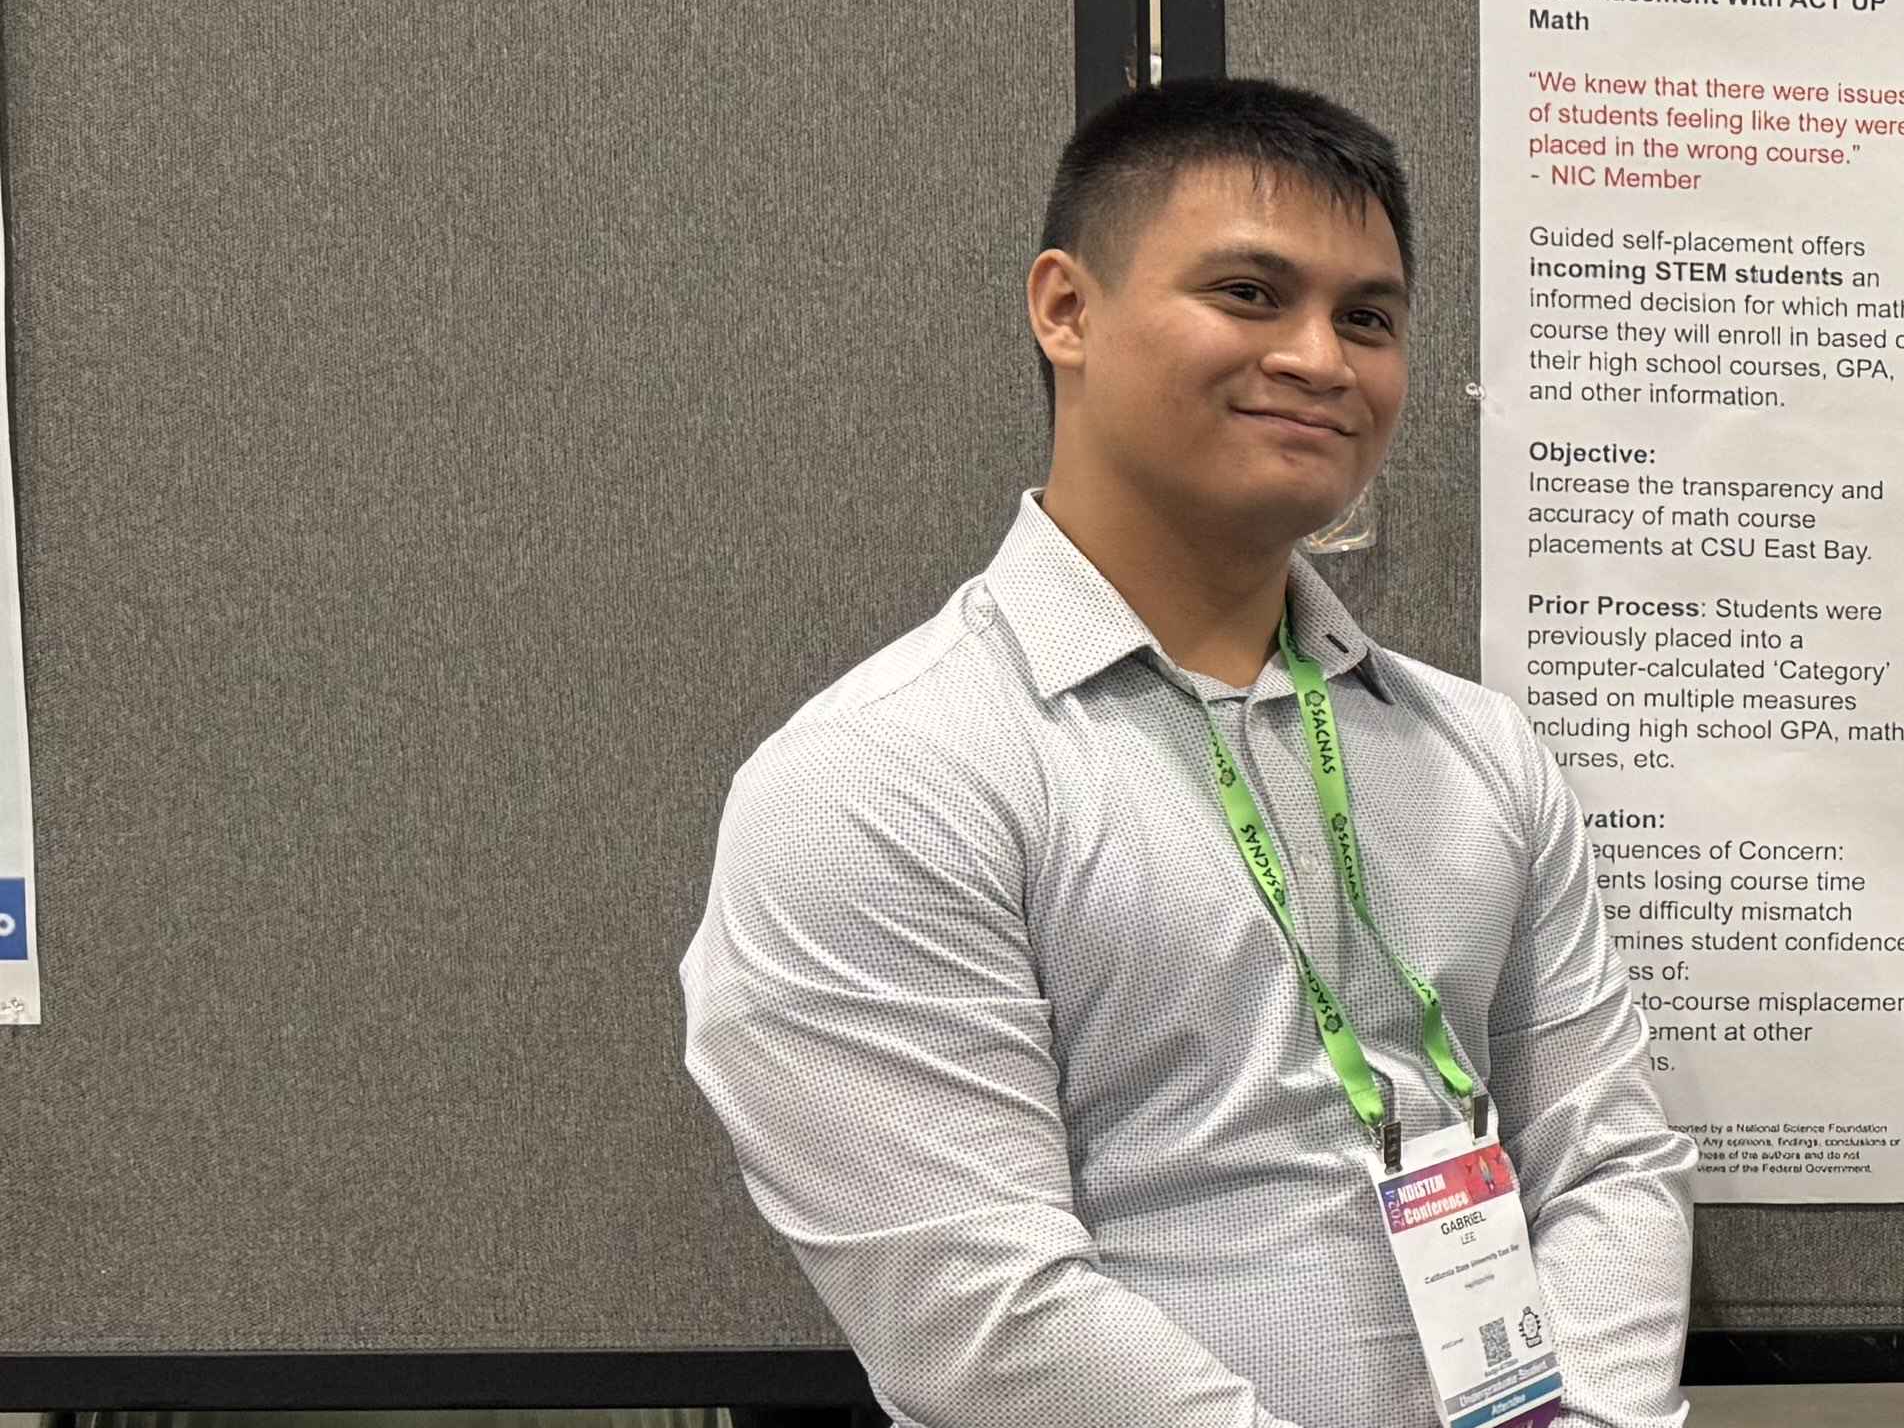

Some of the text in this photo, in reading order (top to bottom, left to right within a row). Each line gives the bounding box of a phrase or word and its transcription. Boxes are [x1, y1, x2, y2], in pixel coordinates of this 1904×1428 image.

[1530, 9, 1588, 30] Math
[1552, 165, 1701, 189] NIC Member
[1530, 442, 1654, 467] Objective:
[1312, 708, 1336, 774] SACNAS
[1240, 824, 1280, 890] SACNAS
[1441, 1212, 1487, 1235] GABRIEL
[1461, 1232, 1477, 1245] LEE
